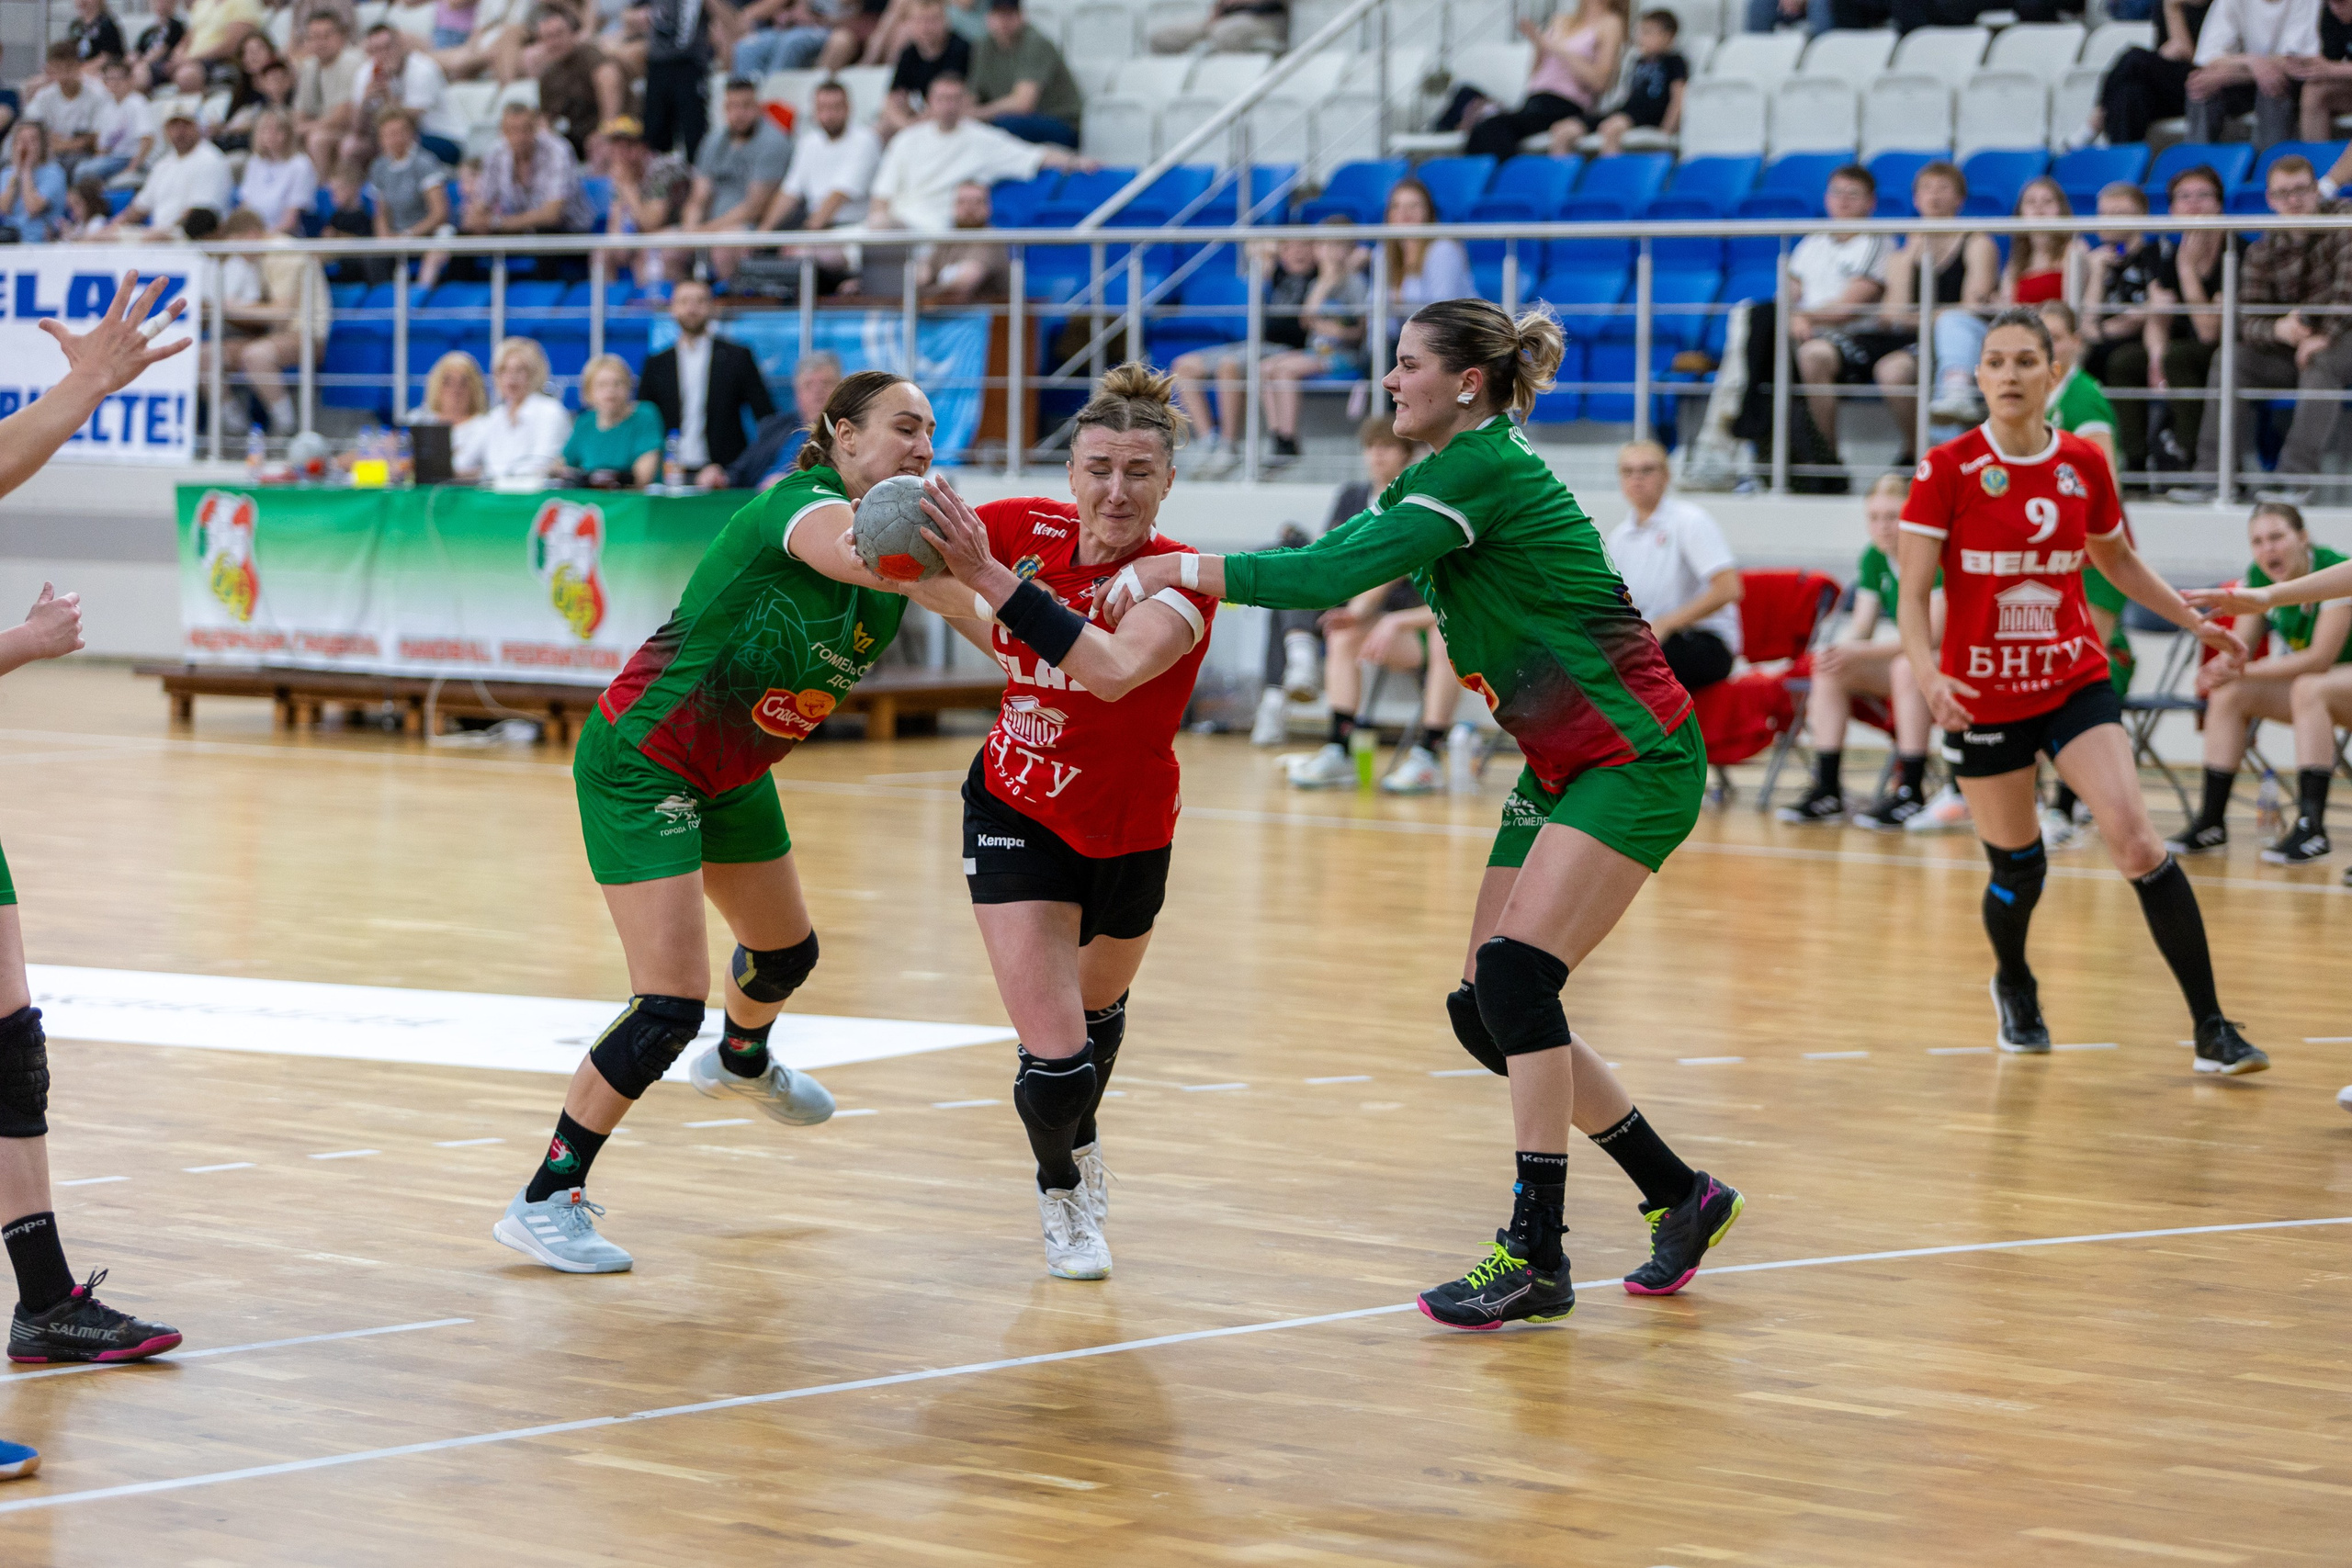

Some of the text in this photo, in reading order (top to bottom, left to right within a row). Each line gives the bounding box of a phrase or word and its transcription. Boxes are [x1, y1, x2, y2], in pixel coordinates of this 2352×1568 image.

[0, 271, 187, 320] LAZ
[2024, 496, 2060, 544] 9
[1966, 637, 2085, 679] БНТУ
[977, 833, 1025, 851] Kempa
